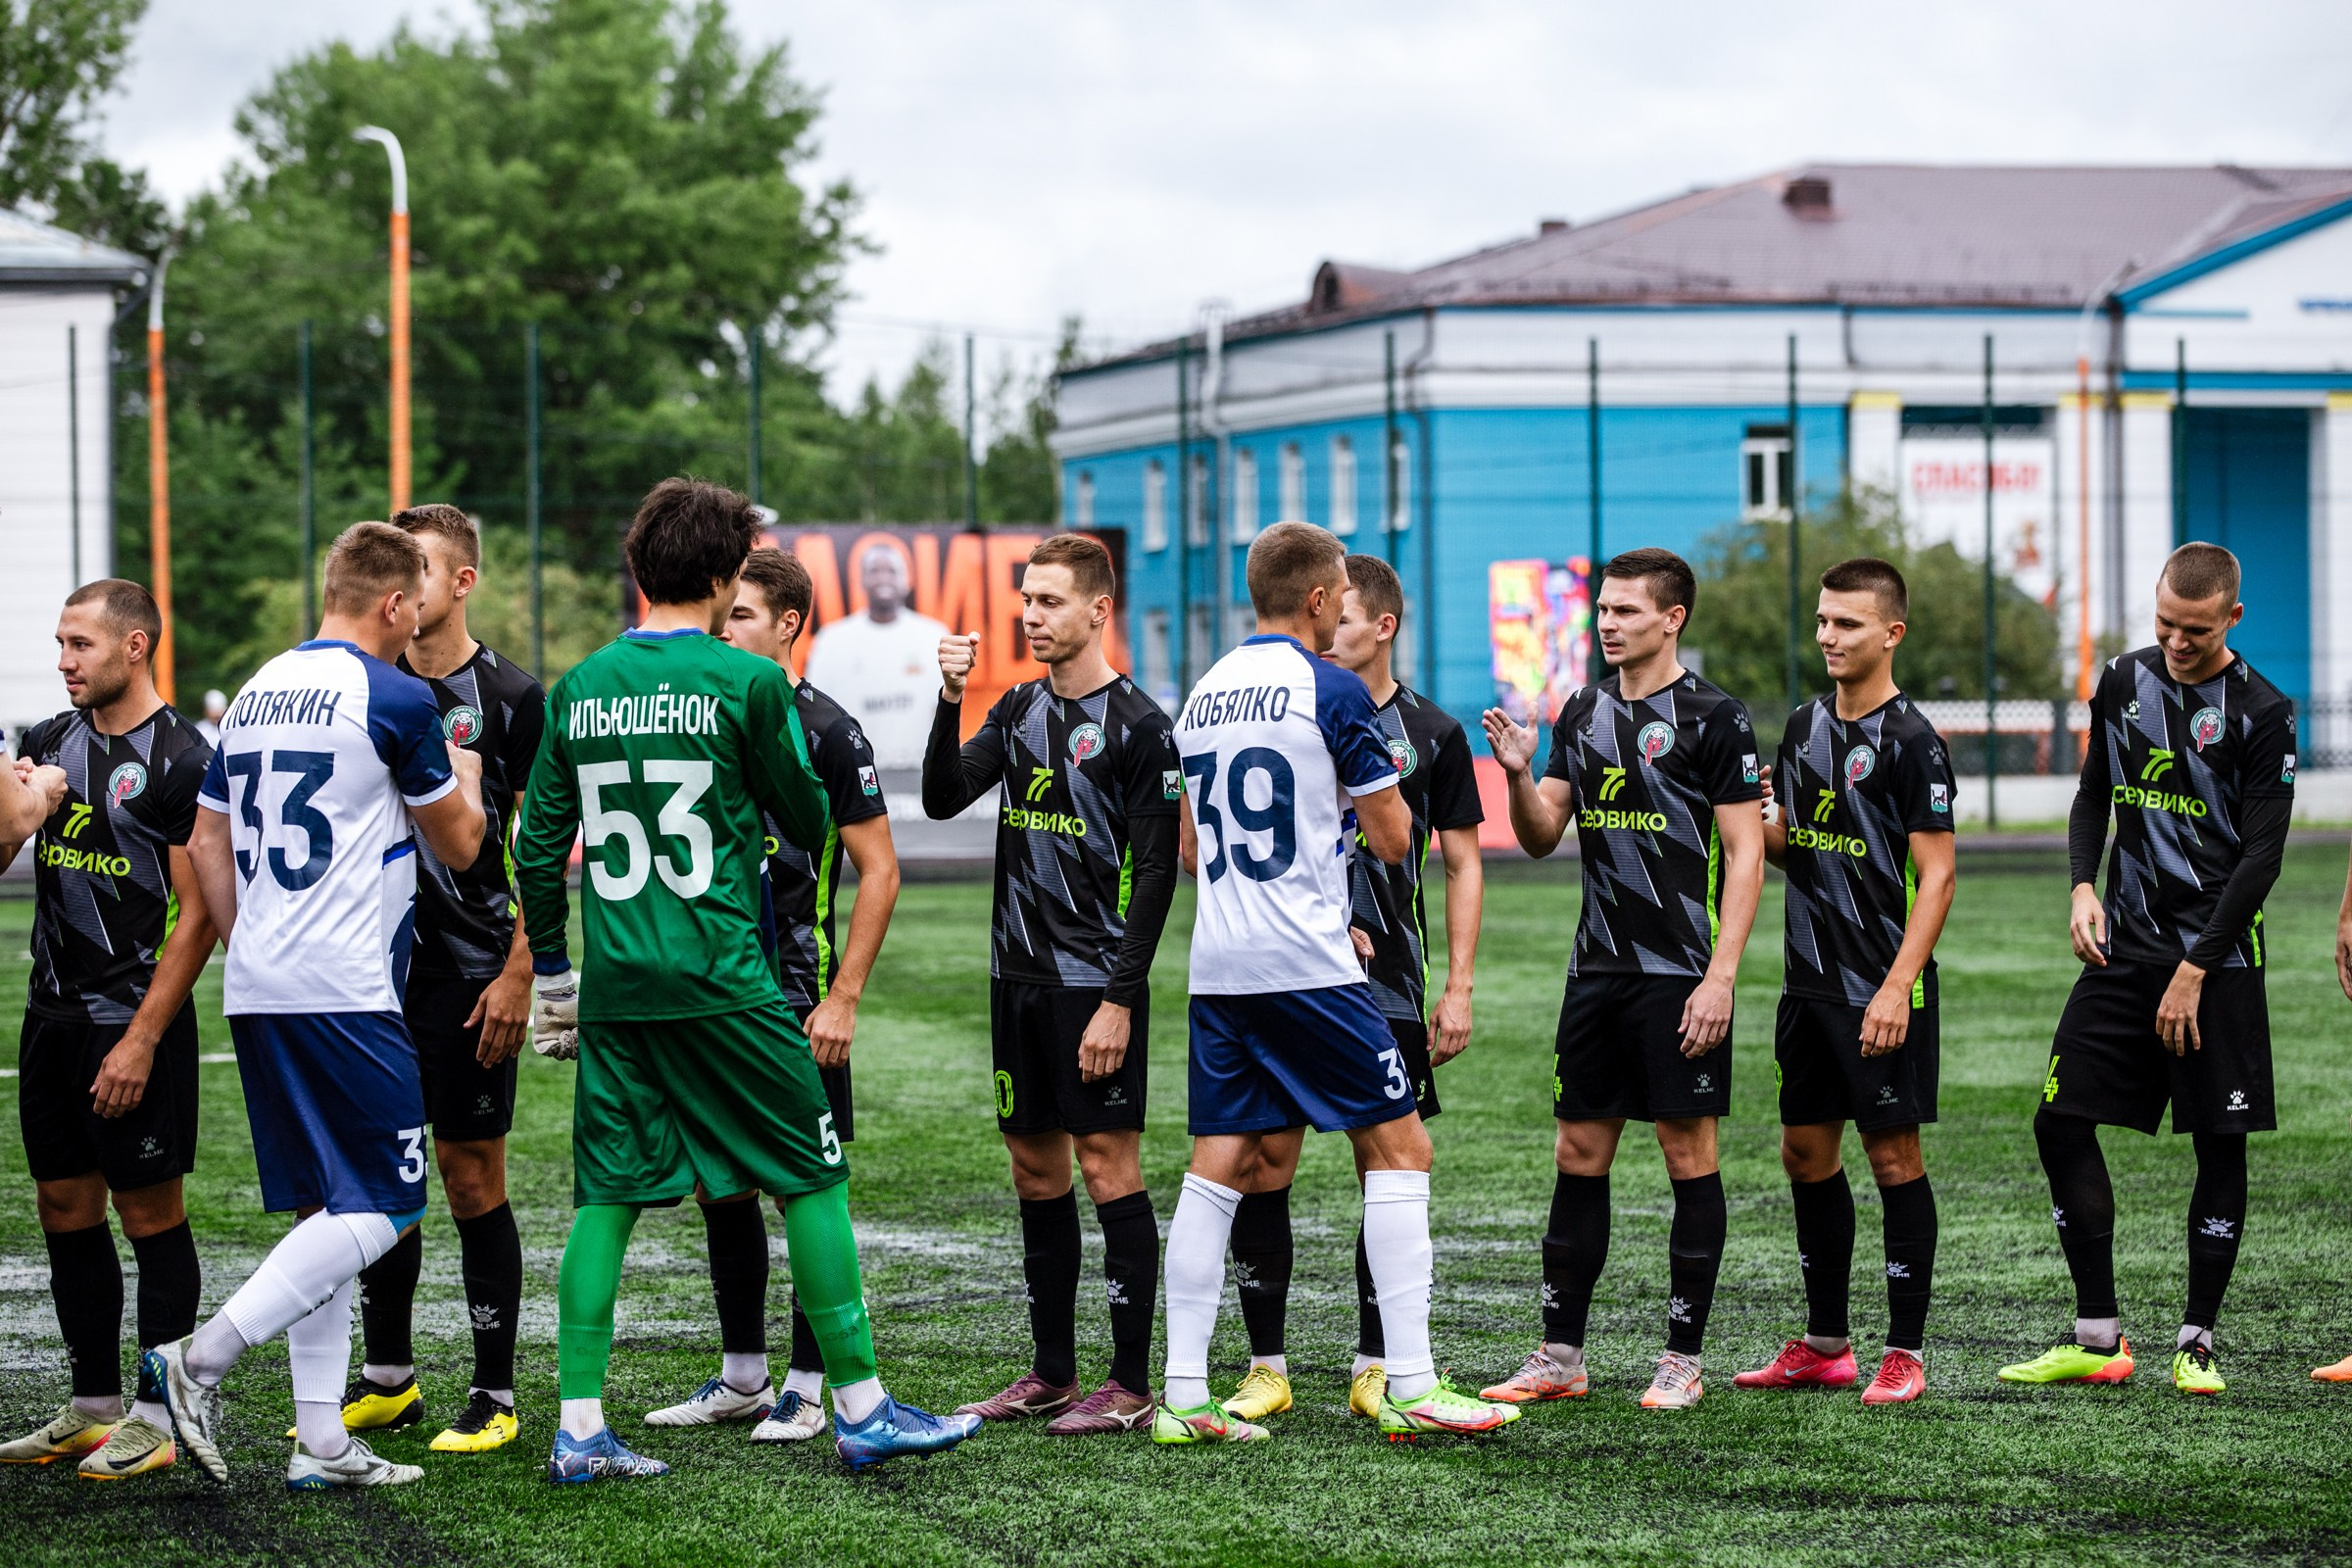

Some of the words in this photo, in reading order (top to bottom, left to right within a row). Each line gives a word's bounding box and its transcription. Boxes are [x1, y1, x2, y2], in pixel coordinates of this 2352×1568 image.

[569, 683, 720, 741] ИЛЬЮШЁНОК
[1185, 685, 1291, 732] КОБЯЛКО
[226, 750, 334, 892] 33
[577, 760, 713, 901] 53
[1182, 747, 1297, 884] 39
[994, 1069, 1013, 1118] 0
[1378, 1048, 1412, 1100] 3
[1104, 1098, 1128, 1106] KELME
[1877, 1098, 1899, 1106] KELME
[139, 1149, 165, 1160] KELME
[398, 1126, 428, 1184] 3
[2201, 1228, 2233, 1240] KELME
